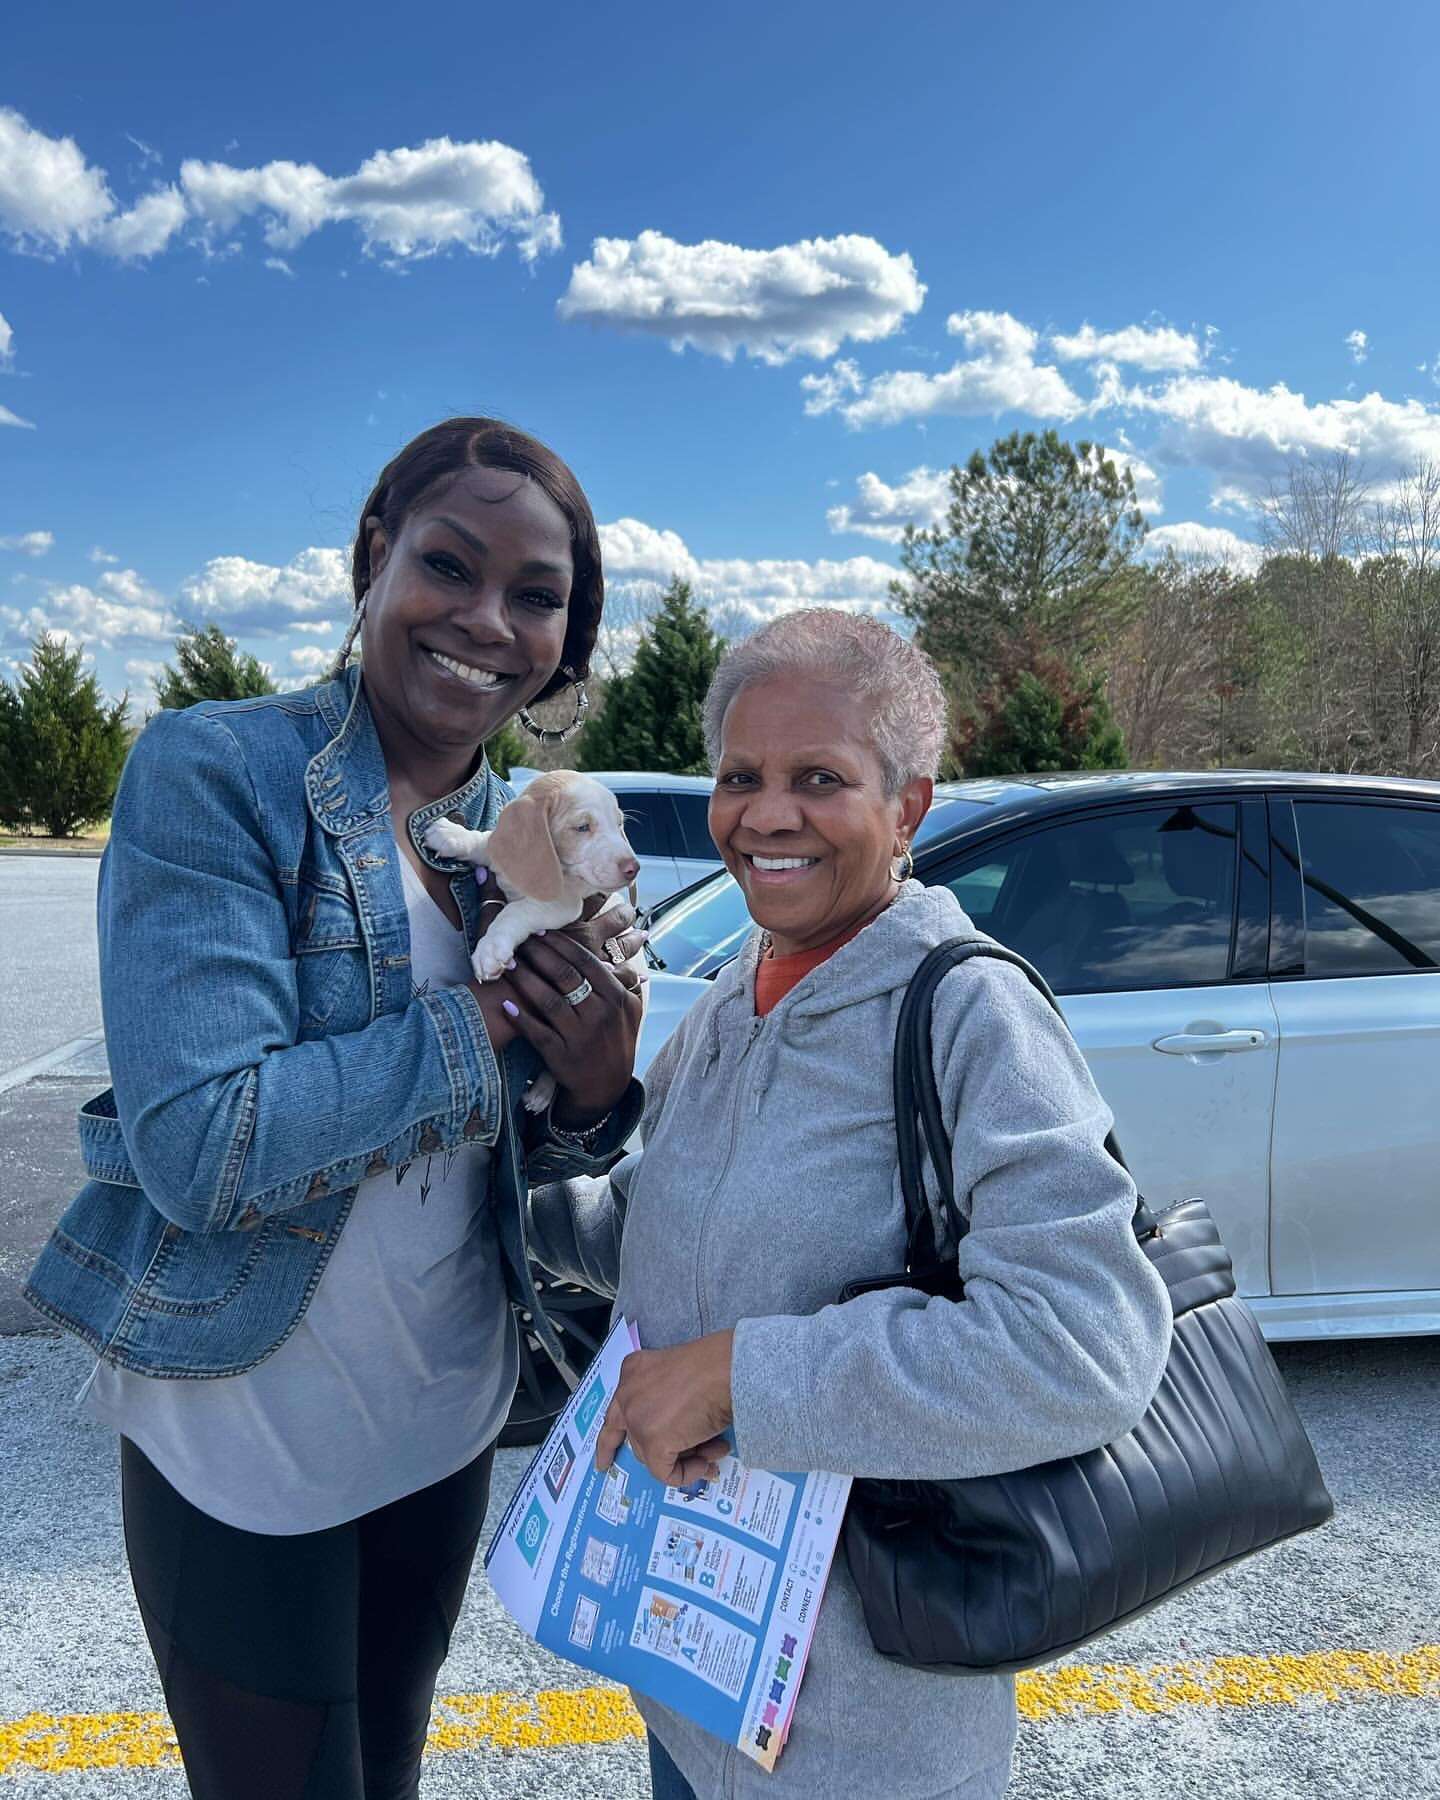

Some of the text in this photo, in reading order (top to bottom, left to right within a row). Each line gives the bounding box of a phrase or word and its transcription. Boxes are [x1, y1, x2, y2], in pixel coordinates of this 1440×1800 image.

[586, 1475, 597, 1498] that
[716, 1499, 733, 1515] C
[565, 1500, 588, 1562] Registration
[560, 1562, 571, 1580] the
[699, 1571, 715, 1589] B
[551, 1579, 564, 1616] Choose
[780, 1578, 795, 1612] CONTACT
[798, 1588, 813, 1623] CONNECT
[681, 1648, 697, 1664] A
